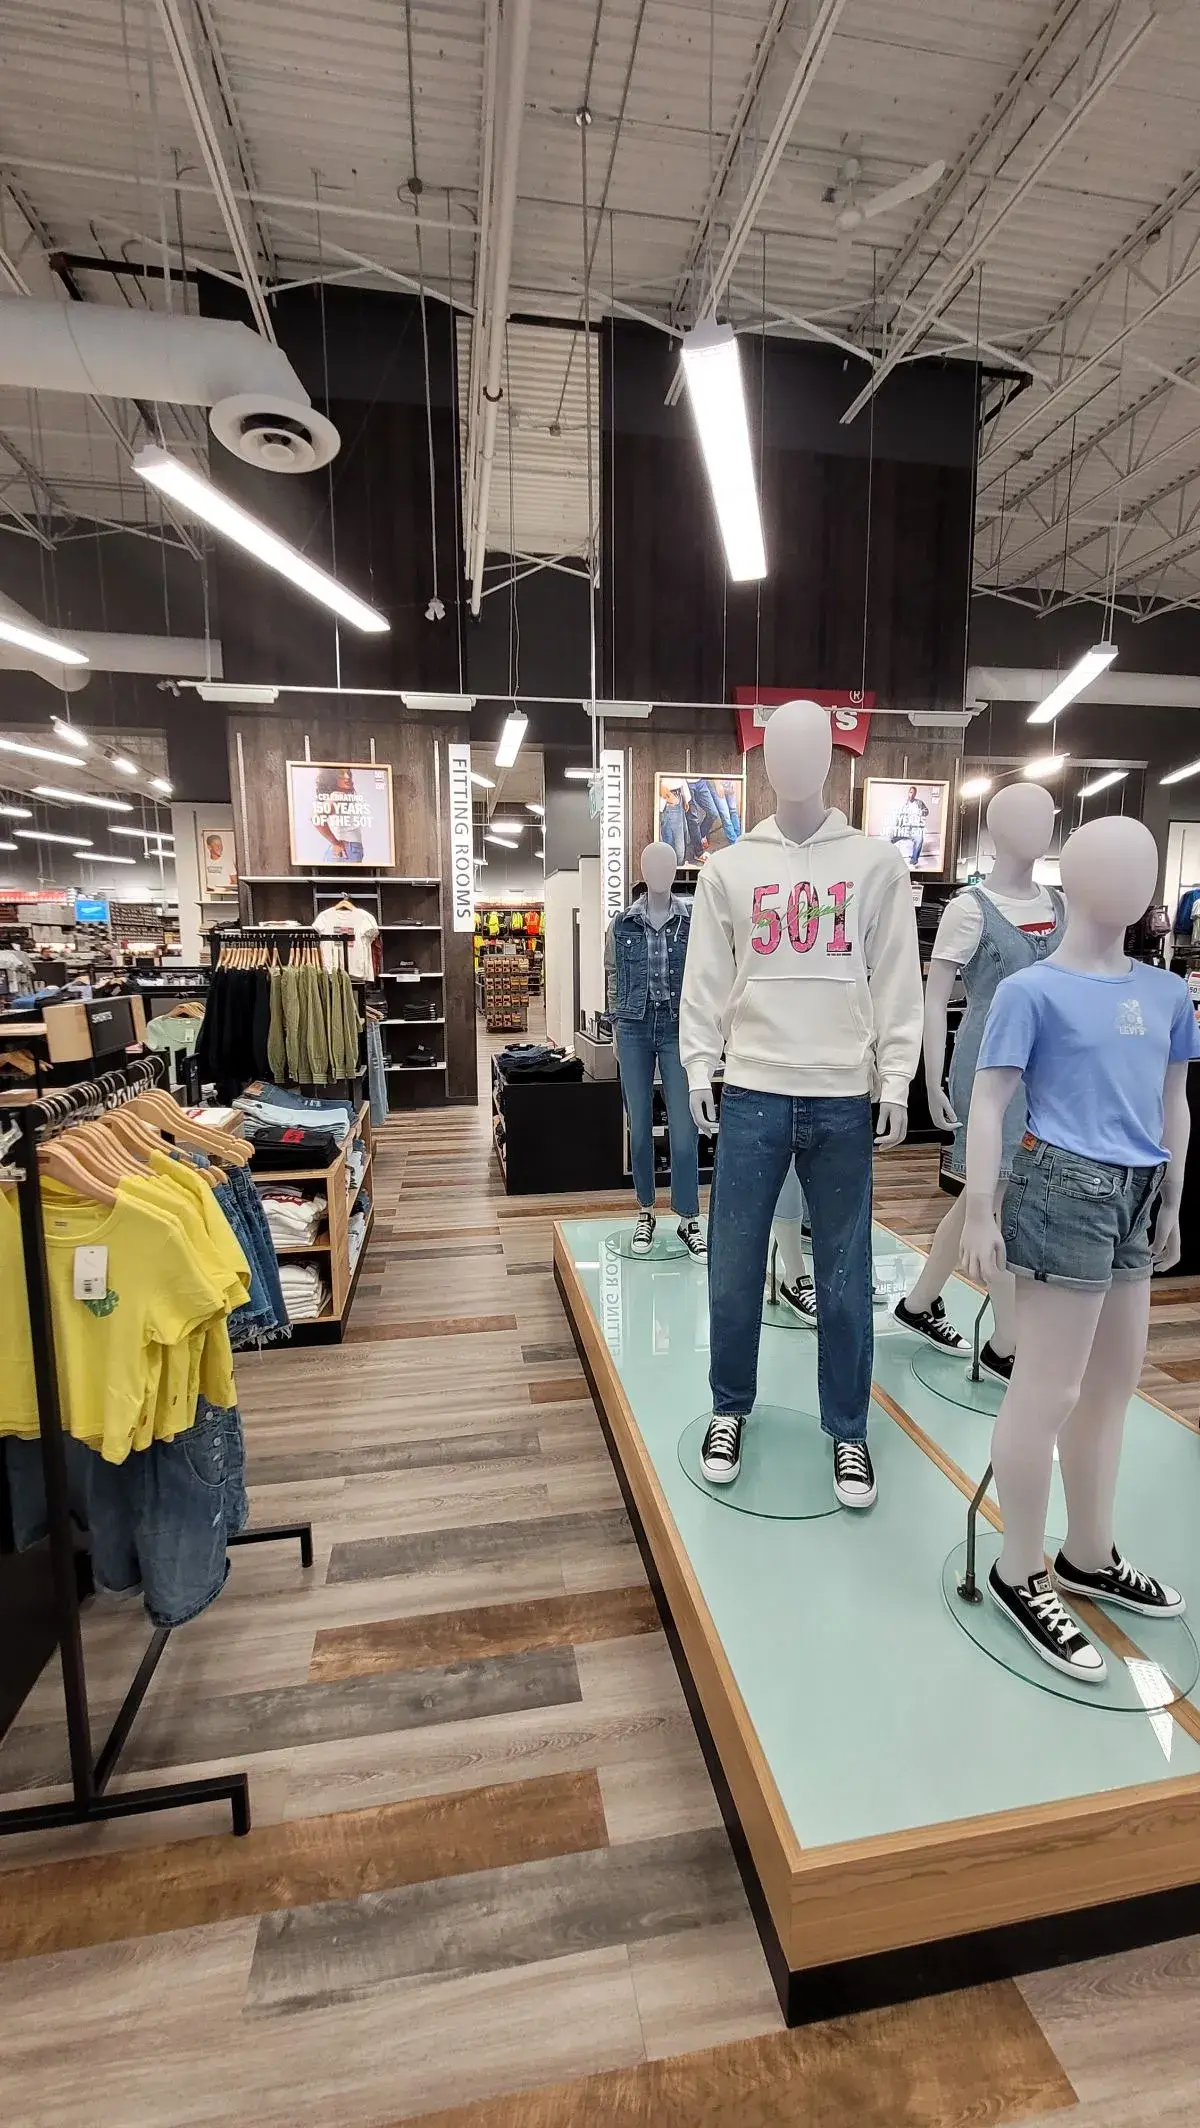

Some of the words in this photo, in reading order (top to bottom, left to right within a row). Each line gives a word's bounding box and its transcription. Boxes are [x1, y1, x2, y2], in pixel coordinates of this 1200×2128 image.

[312, 802, 332, 814] 150
[334, 802, 371, 815] YEARS
[312, 815, 328, 827] OF
[332, 815, 351, 827] THE
[452, 759, 469, 835] FITTING
[607, 764, 621, 839] FITTING
[455, 844, 471, 919] ROOMS
[607, 847, 622, 919] ROOMS
[751, 881, 853, 955] 501
